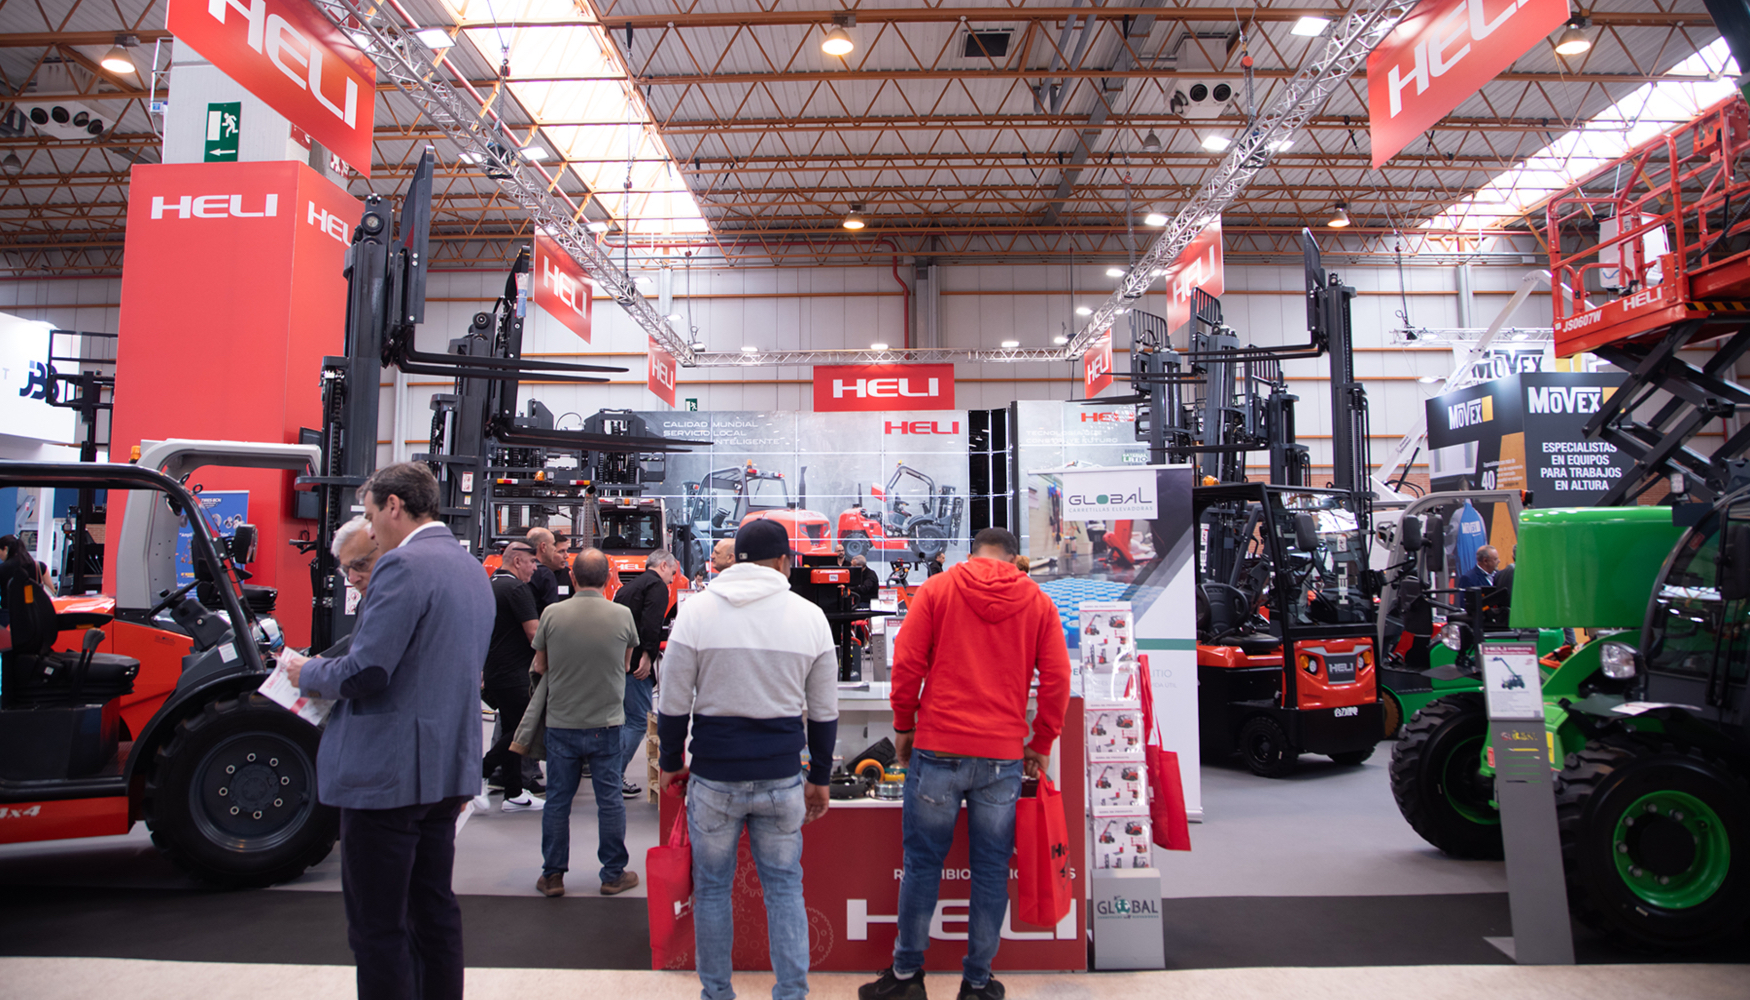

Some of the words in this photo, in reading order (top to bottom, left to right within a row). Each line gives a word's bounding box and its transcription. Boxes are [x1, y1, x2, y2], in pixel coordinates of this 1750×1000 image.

[208, 0, 358, 130] HELI
[1387, 0, 1522, 119] HEL
[150, 193, 279, 220] HELI
[307, 200, 352, 248] HEL
[543, 254, 588, 320] HELI
[1172, 244, 1216, 310] HELI
[1622, 286, 1662, 312] HELI
[1562, 309, 1602, 333] JS0607W
[652, 354, 674, 391] HELI
[1087, 348, 1109, 385] HELI
[832, 377, 940, 399] HELI
[1527, 386, 1602, 414] MOVEX
[1448, 397, 1482, 431] MOVEX
[884, 420, 960, 435] HELI
[1541, 442, 1618, 453] ESPECIALISTAS
[1551, 454, 1566, 466] EN
[1567, 454, 1610, 466] EQUIPOS
[1481, 470, 1496, 490] 40
[1540, 467, 1568, 478] PARA
[1569, 467, 1623, 478] TRABAJOS
[1068, 486, 1153, 506] GLOBAL
[1554, 480, 1569, 491] EN
[1570, 480, 1610, 491] ALTURA
[1112, 505, 1154, 513] ELEVADORAS
[1338, 562, 1349, 605] HELI
[1329, 662, 1354, 673] HELI
[1097, 898, 1159, 915] GLOBAL
